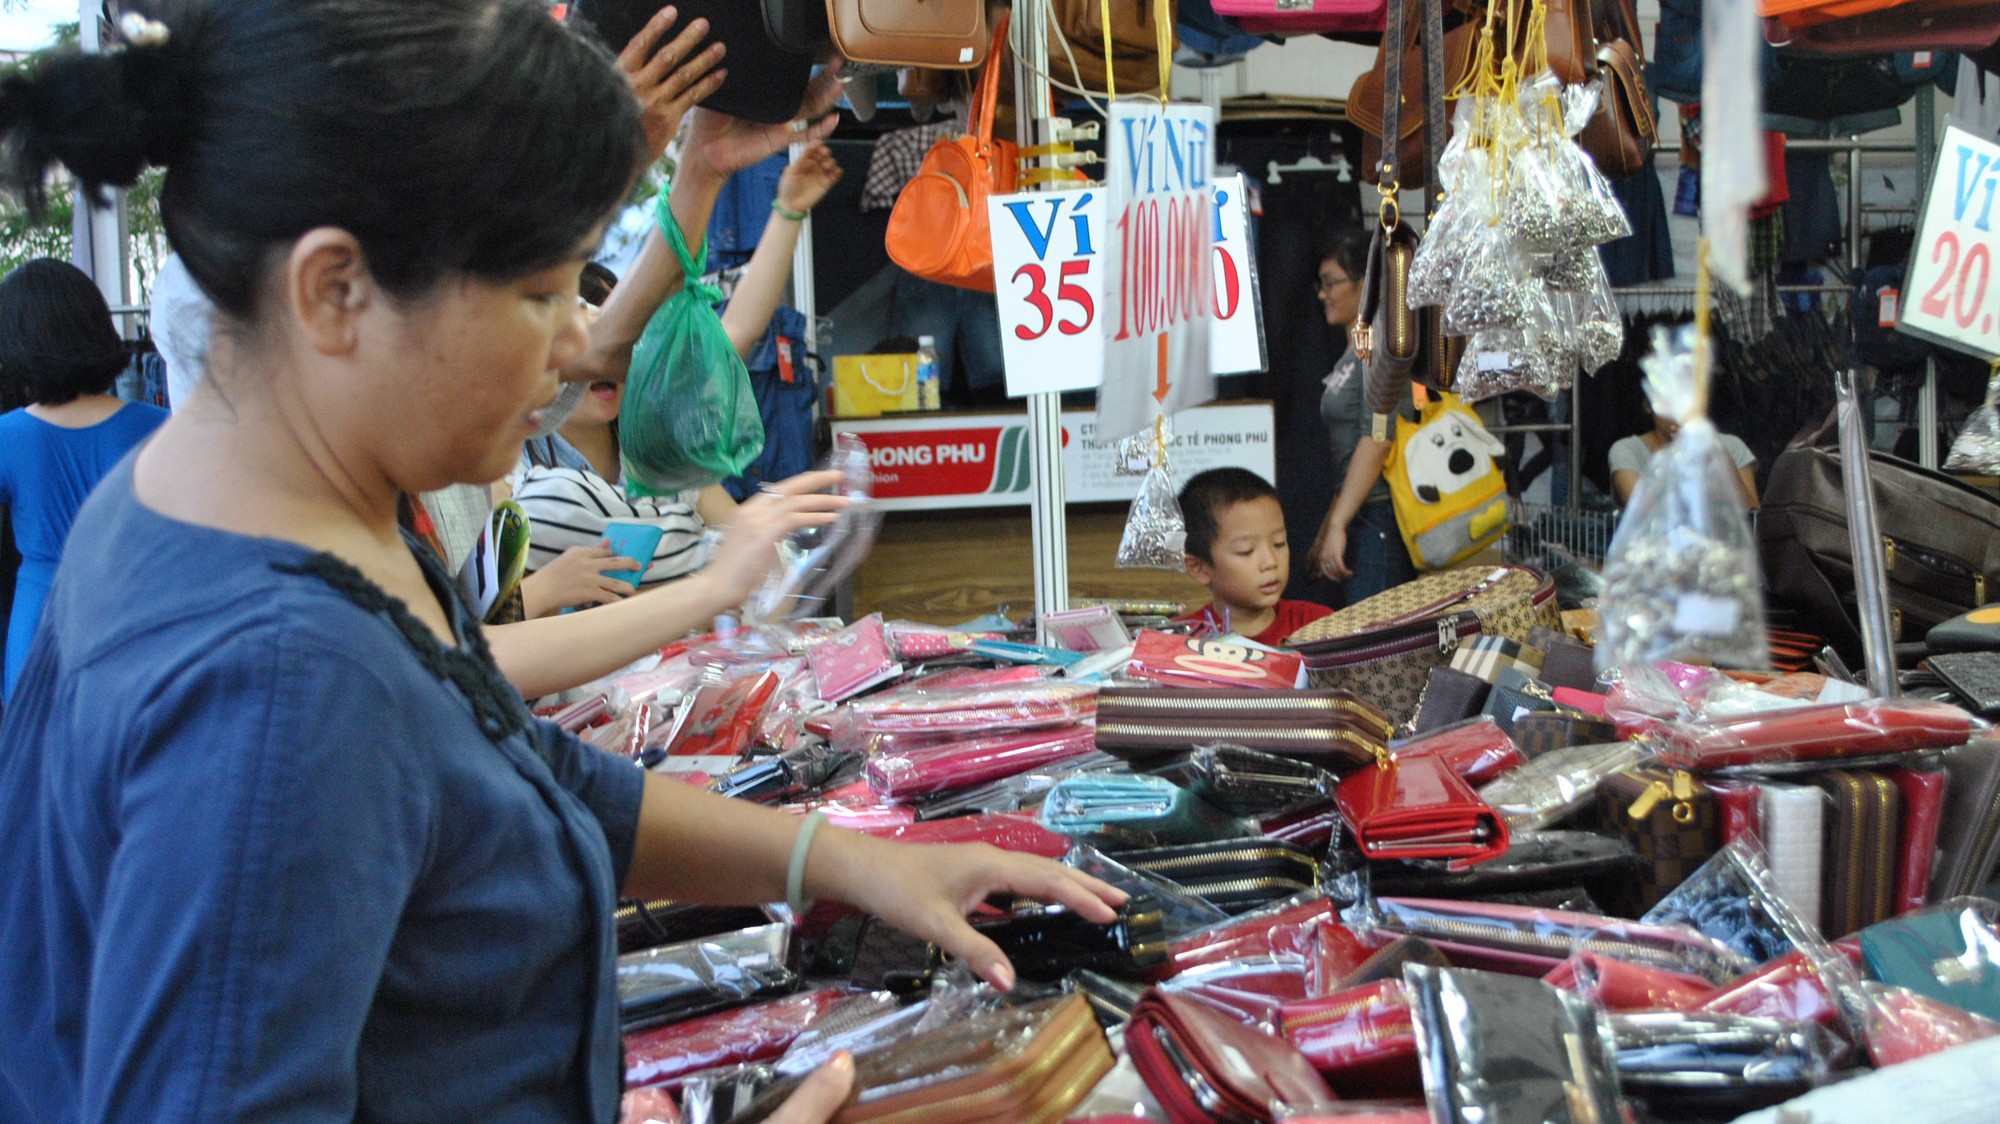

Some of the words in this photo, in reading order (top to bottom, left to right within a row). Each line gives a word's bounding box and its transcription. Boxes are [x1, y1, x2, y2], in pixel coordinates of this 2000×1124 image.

[1120, 114, 1158, 196] Ví
[1954, 144, 2000, 232] Ví
[1002, 192, 1096, 261] Ví
[1114, 194, 1209, 341] 100.000
[1920, 231, 2000, 335] 20.
[867, 444, 932, 467] HONG
[936, 443, 986, 465] PHU
[1204, 432, 1243, 445] PHONG
